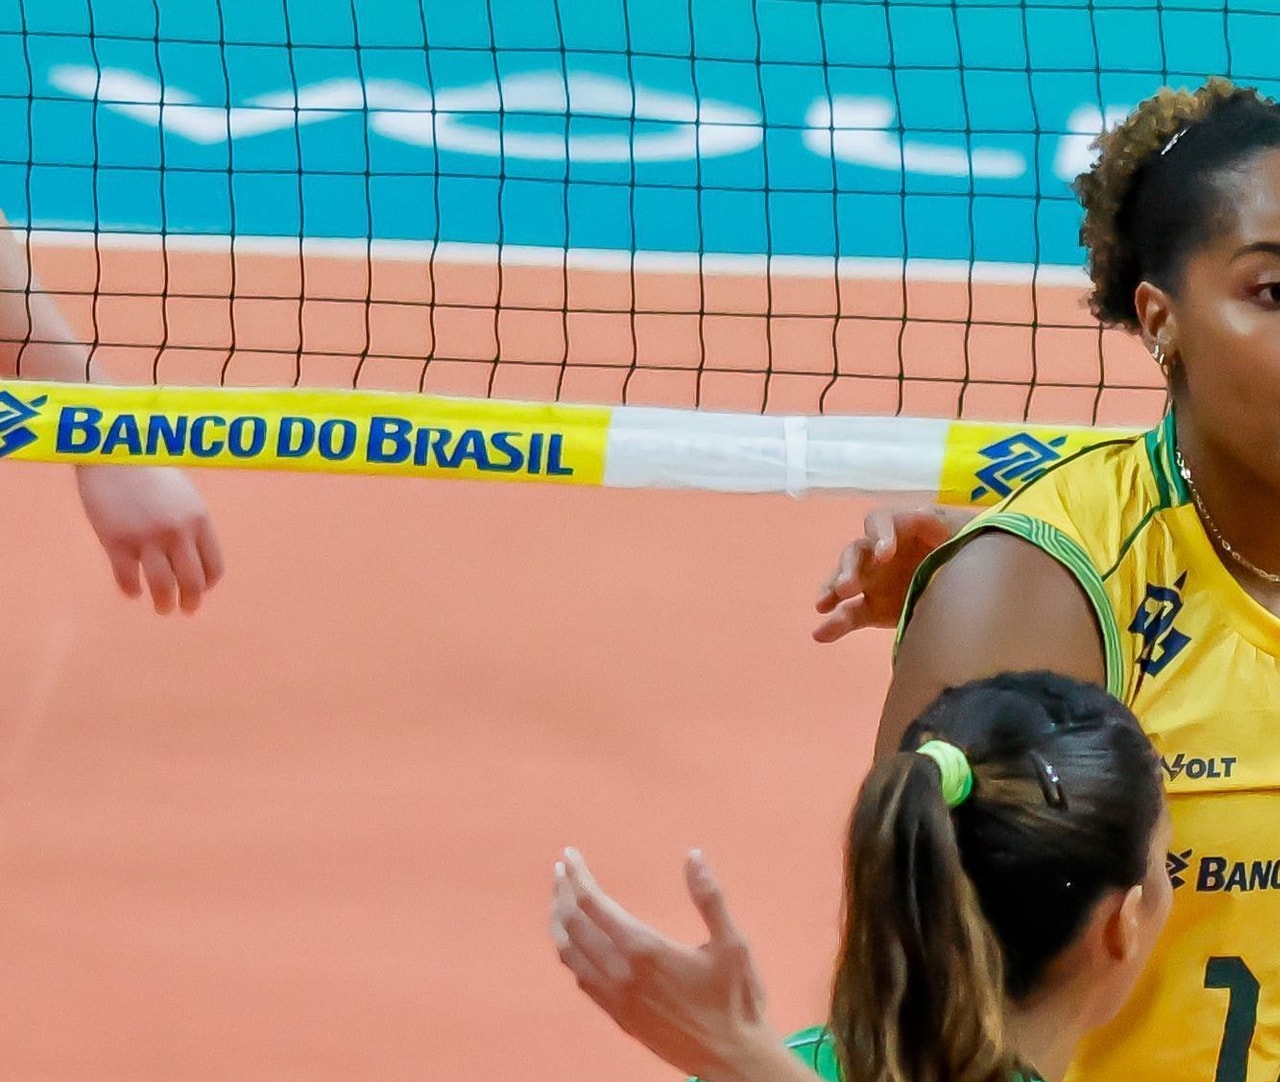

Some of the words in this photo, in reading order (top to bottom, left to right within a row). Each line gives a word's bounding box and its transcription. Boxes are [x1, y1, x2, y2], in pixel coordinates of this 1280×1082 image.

[56, 405, 267, 459] BANCO
[276, 415, 358, 460] DO
[365, 416, 574, 476] BRASIL
[1161, 752, 1237, 782] VOLT
